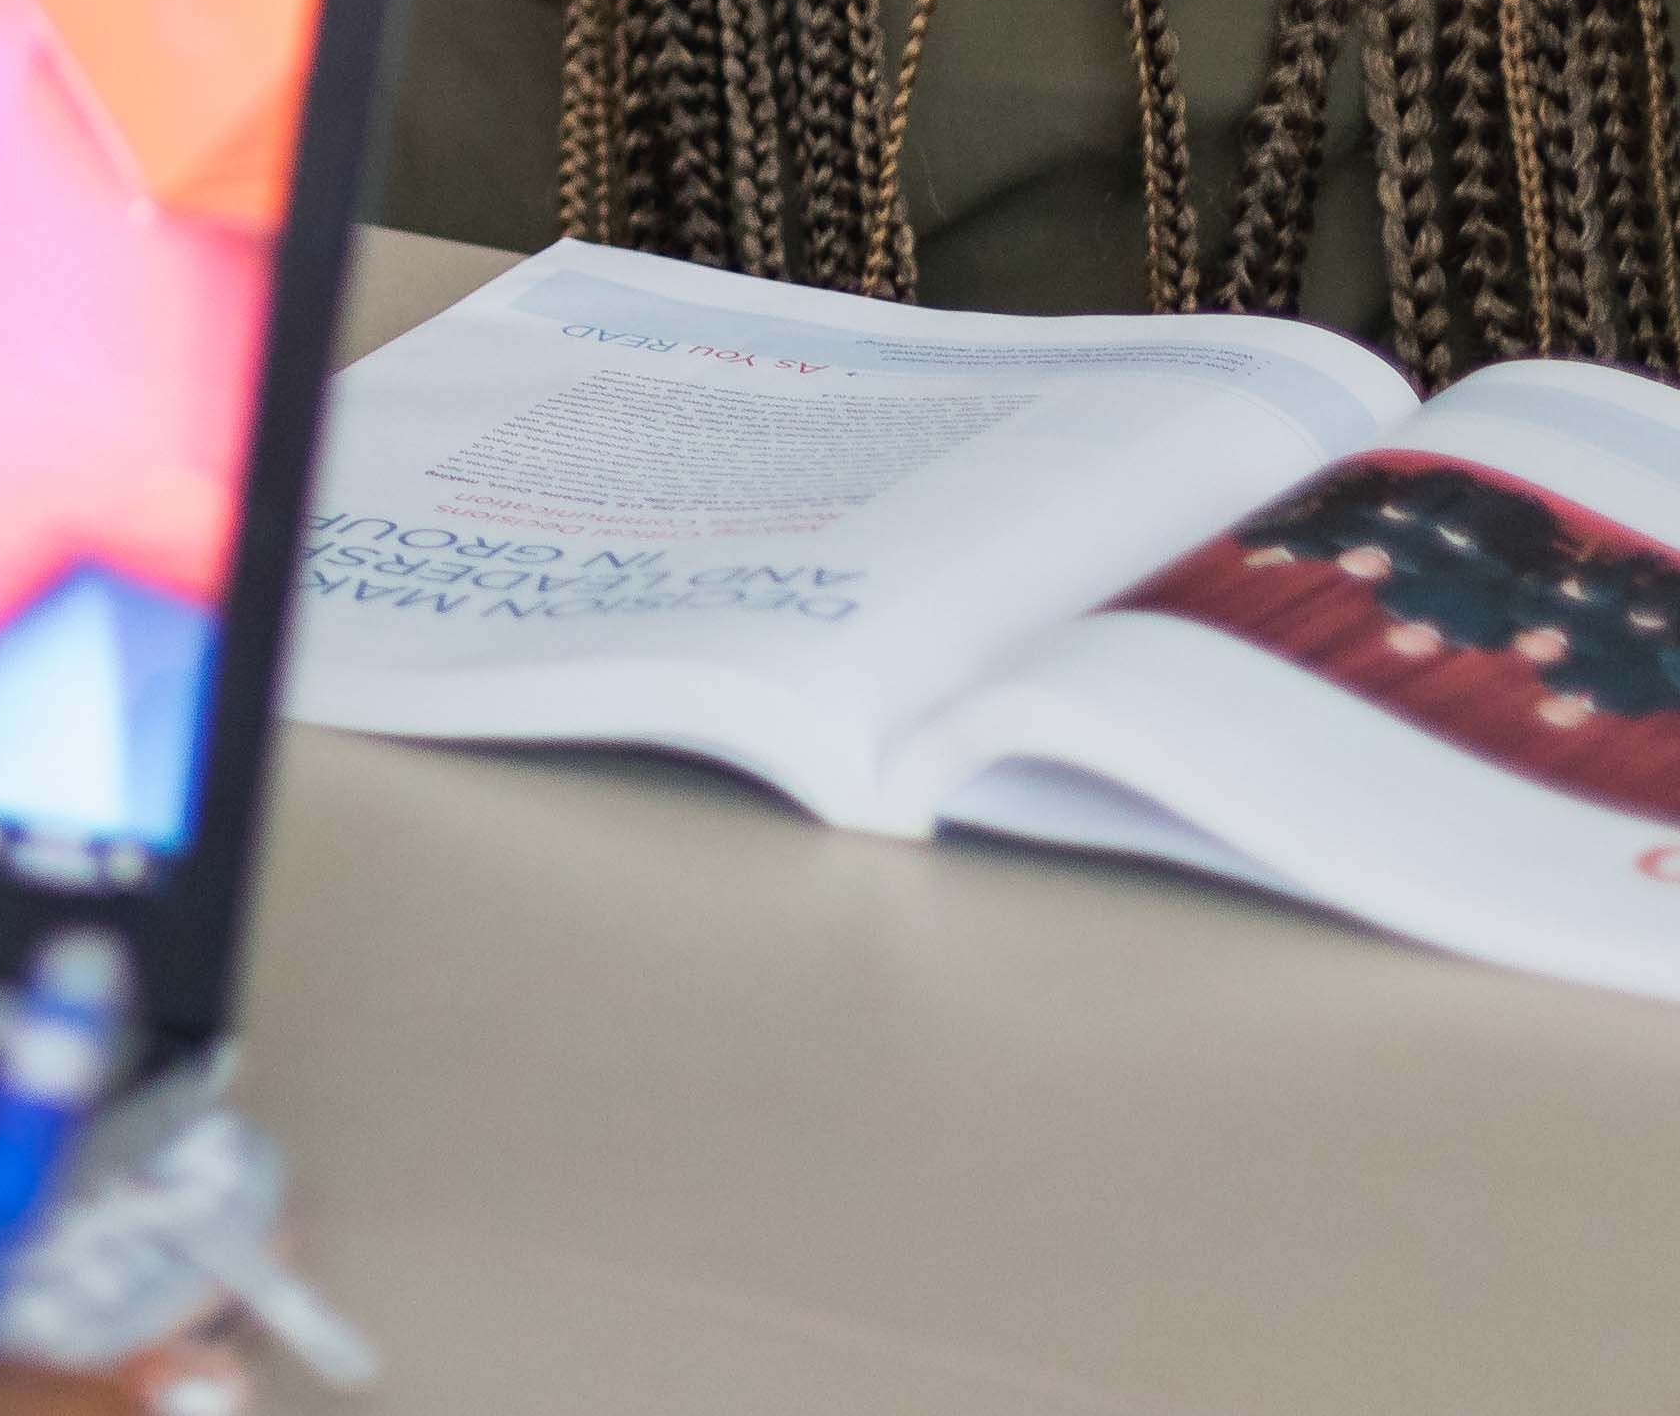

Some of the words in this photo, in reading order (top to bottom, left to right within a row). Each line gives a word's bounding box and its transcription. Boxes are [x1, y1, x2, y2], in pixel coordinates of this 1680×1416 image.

[562, 324, 678, 352] READ
[433, 505, 584, 535] Decisions
[577, 550, 665, 569] IN
[688, 566, 866, 589] AND
[481, 590, 858, 621] DECISION
